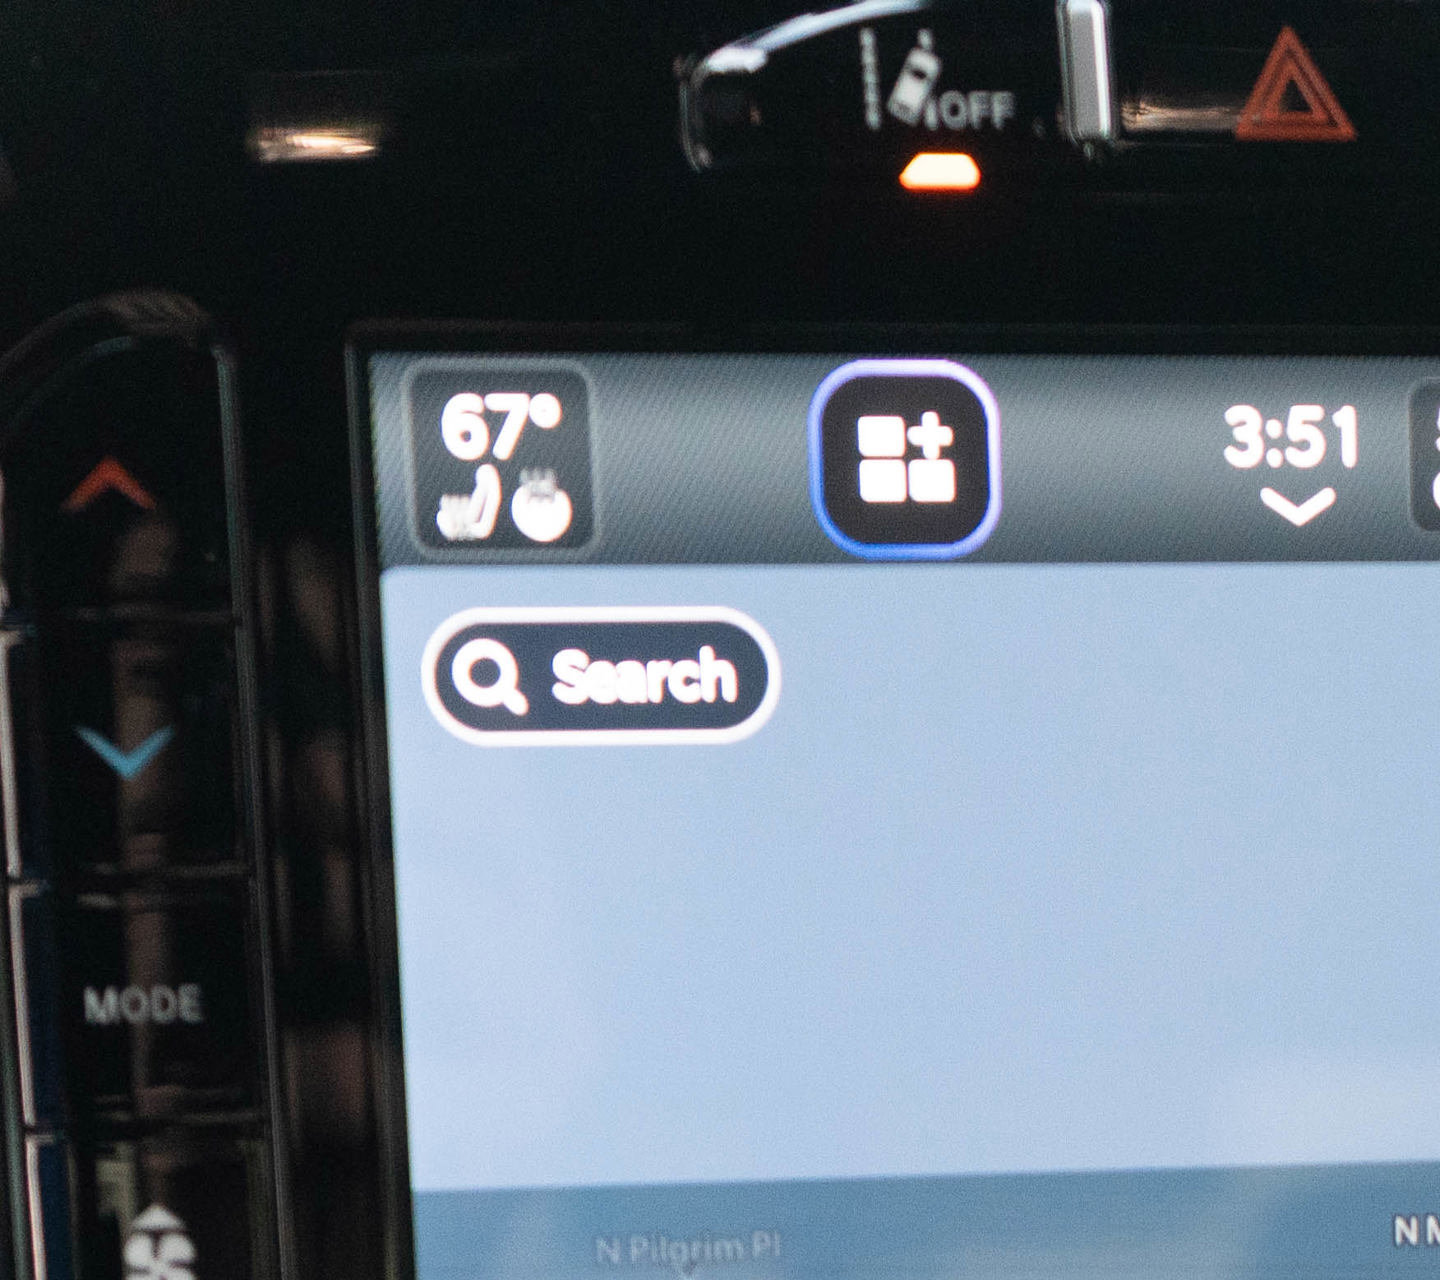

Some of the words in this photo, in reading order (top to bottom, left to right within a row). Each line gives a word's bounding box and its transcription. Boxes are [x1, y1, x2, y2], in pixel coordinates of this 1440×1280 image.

[940, 90, 1015, 130] OFF
[1223, 404, 1358, 469] 3:51
[551, 645, 738, 705] Search
[83, 984, 204, 1025] MODE
[594, 1236, 621, 1264] N
[1394, 1215, 1420, 1246] N
